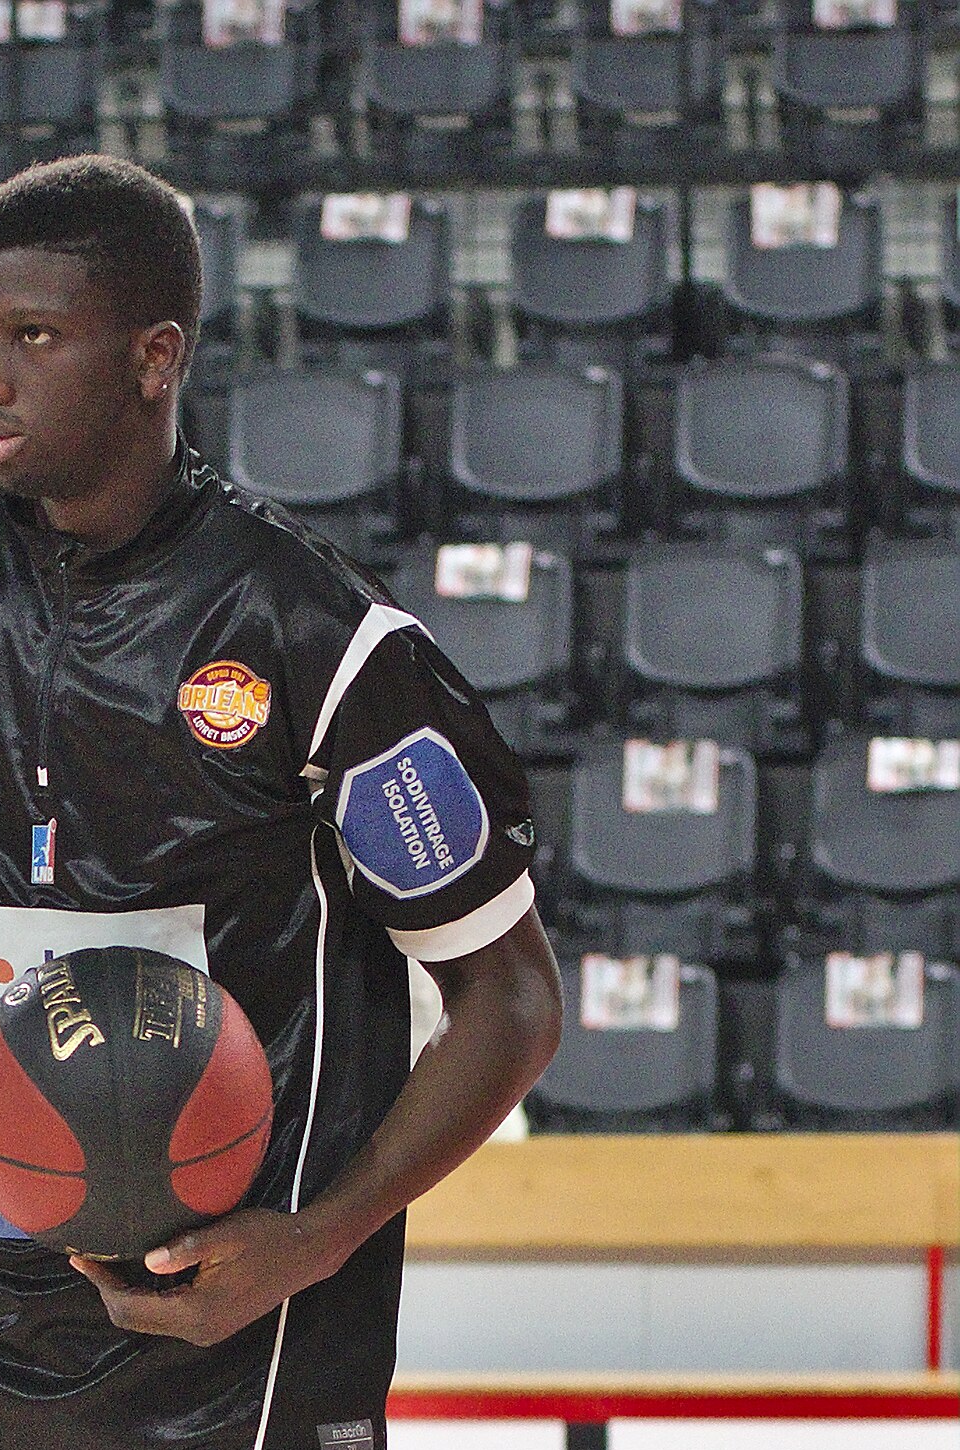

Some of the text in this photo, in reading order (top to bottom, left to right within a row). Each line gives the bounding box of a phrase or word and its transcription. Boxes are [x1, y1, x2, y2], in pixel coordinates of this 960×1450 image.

[193, 715, 251, 742] LOIRET BASKET
[381, 778, 431, 870] ISOLATION
[397, 757, 454, 870] SODIVITRAGE
